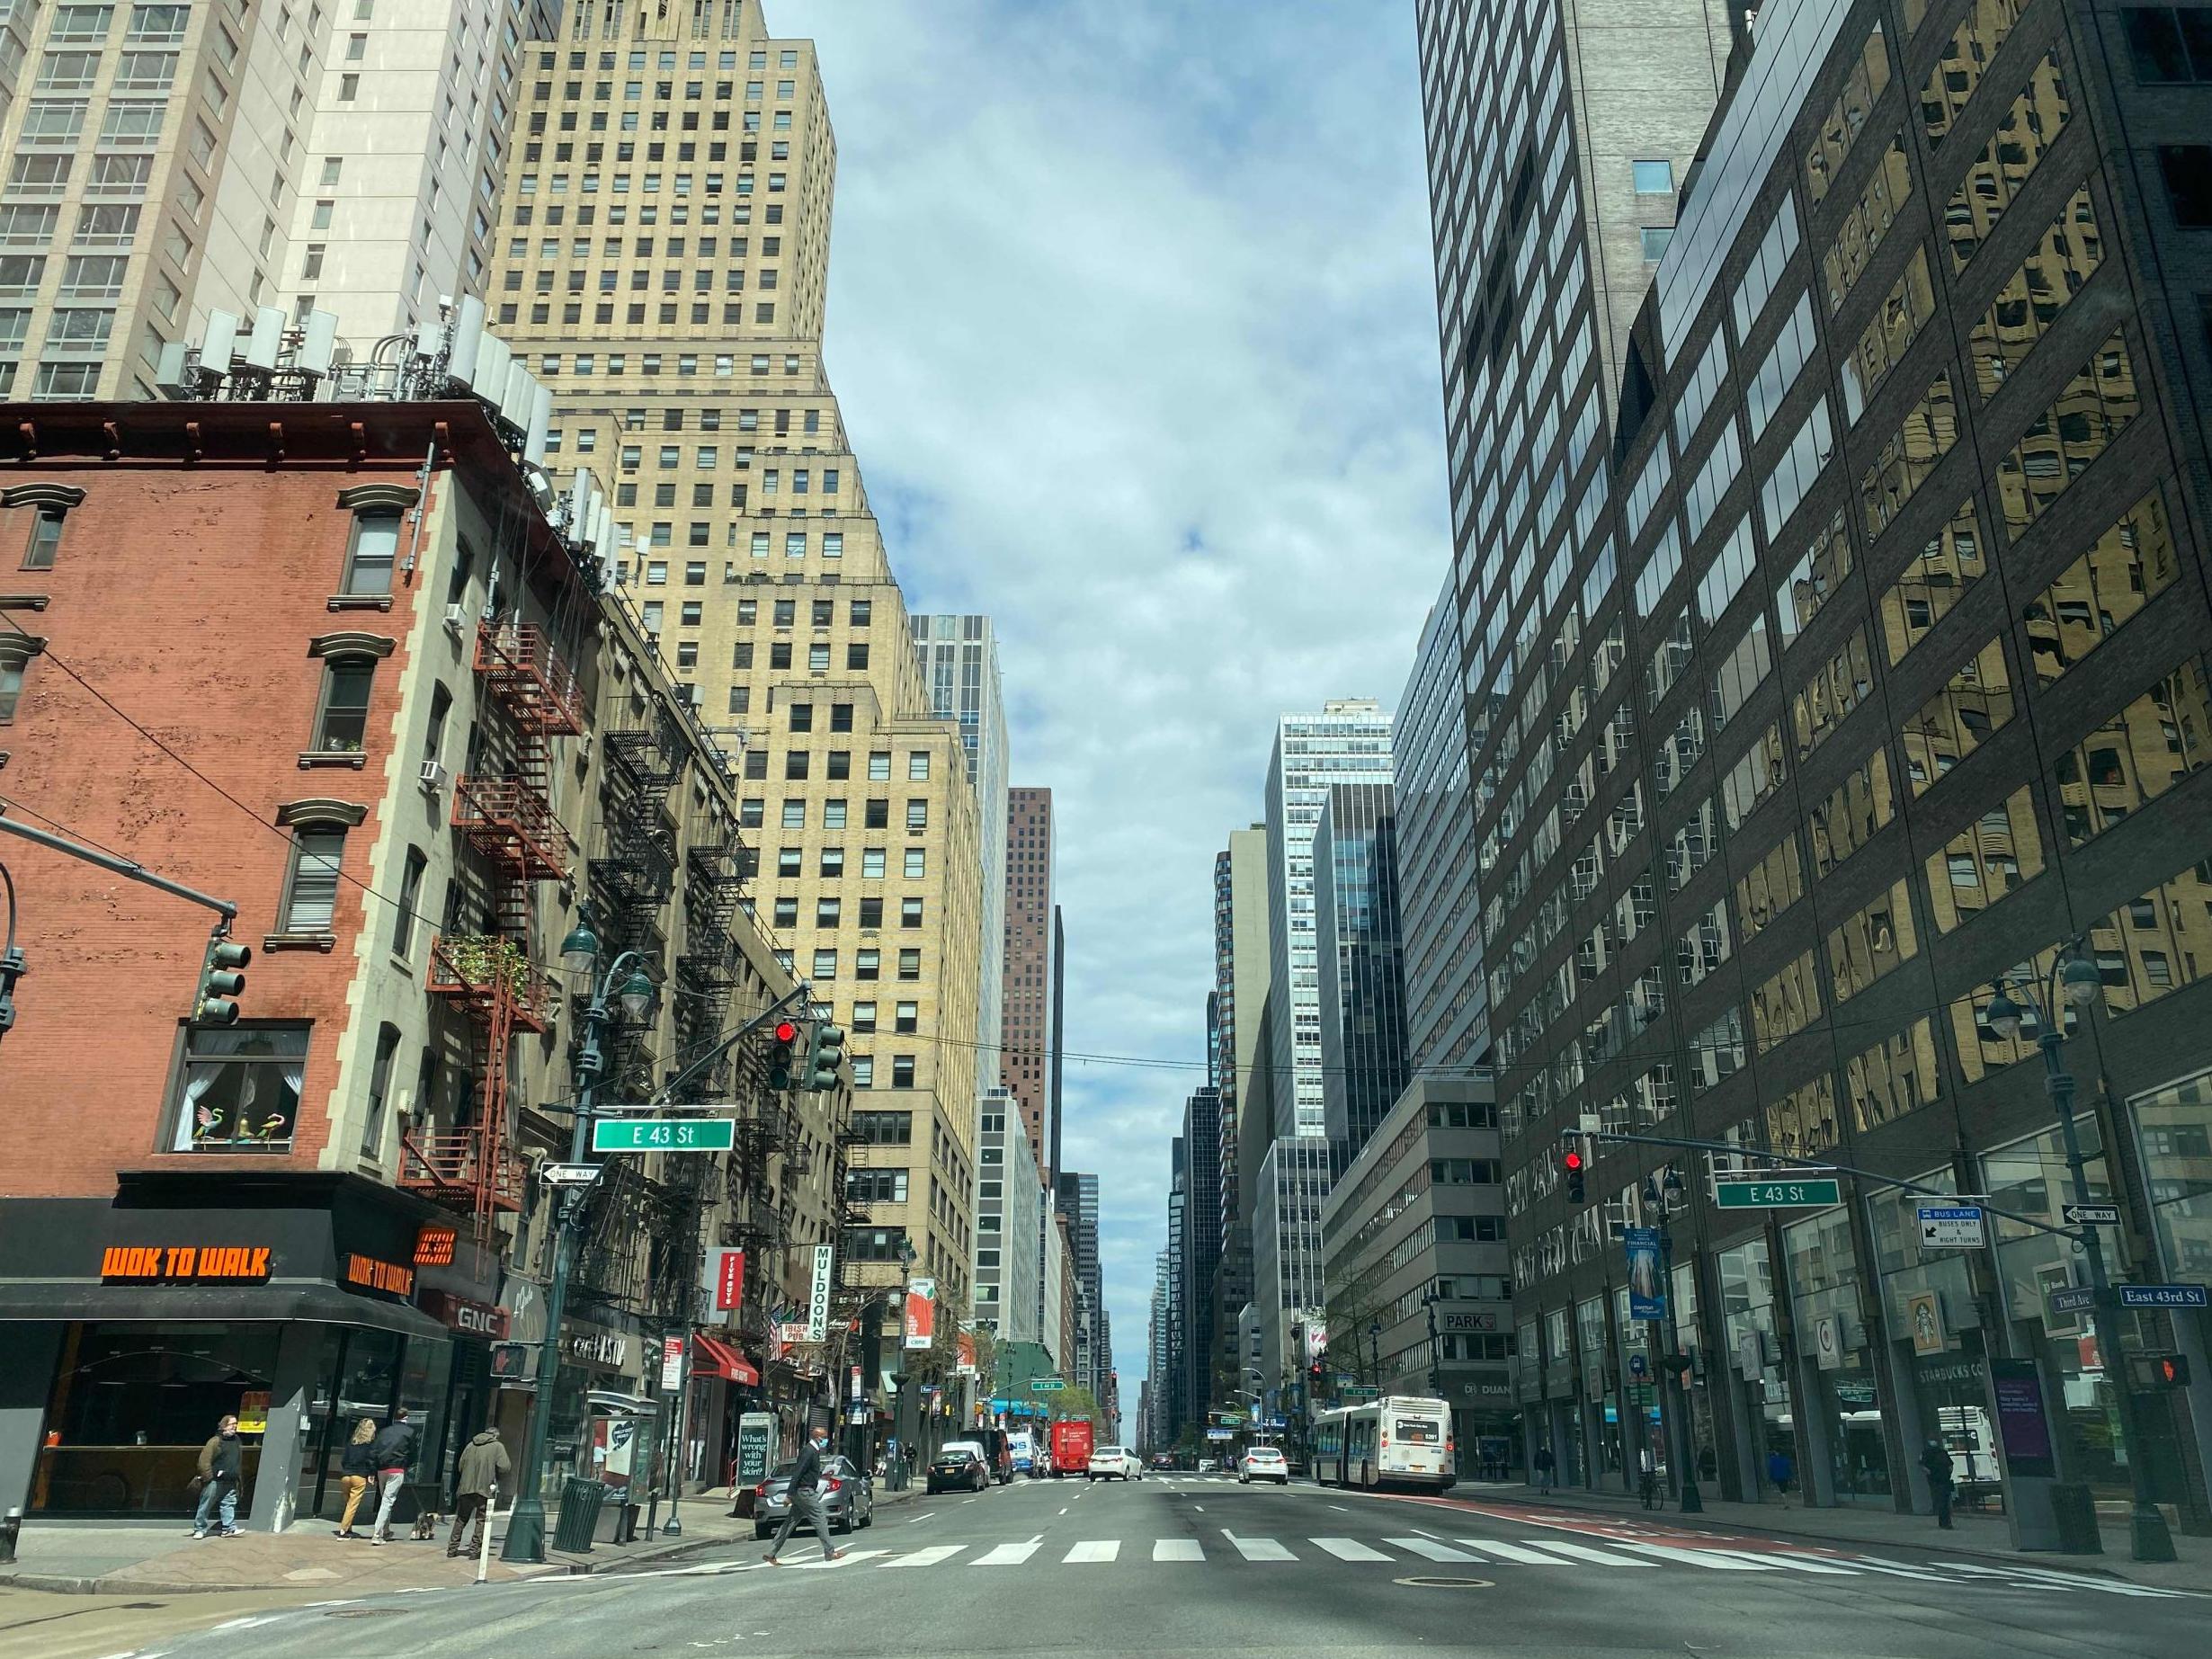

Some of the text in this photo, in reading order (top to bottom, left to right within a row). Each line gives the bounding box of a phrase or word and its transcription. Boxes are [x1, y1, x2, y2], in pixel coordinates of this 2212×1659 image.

[633, 1127, 694, 1144] E 43 St
[549, 1170, 594, 1178] ONE WAY
[1750, 1186, 1805, 1201] E 43 St
[2071, 1210, 2112, 1219] ONE WAY
[101, 1247, 270, 1277] WOK TO WALK
[348, 1253, 414, 1296] WOK TO WALK
[725, 1256, 736, 1305] FIVE GUYS
[813, 1247, 829, 1340] MULDOON'S
[2125, 1290, 2201, 1302] East 43rd St
[2057, 1295, 2090, 1308] Third Ave
[458, 1307, 498, 1334] GNC
[1446, 1315, 1483, 1328] PARK
[784, 1325, 808, 1333] IRISH
[787, 1333, 804, 1341] PUB
[1919, 1364, 1969, 1383] STARBUCKS
[741, 1434, 767, 1443] What's
[741, 1444, 766, 1452] wrong
[745, 1451, 762, 1459] with
[744, 1460, 763, 1468] your
[742, 1467, 763, 1476] skin?
